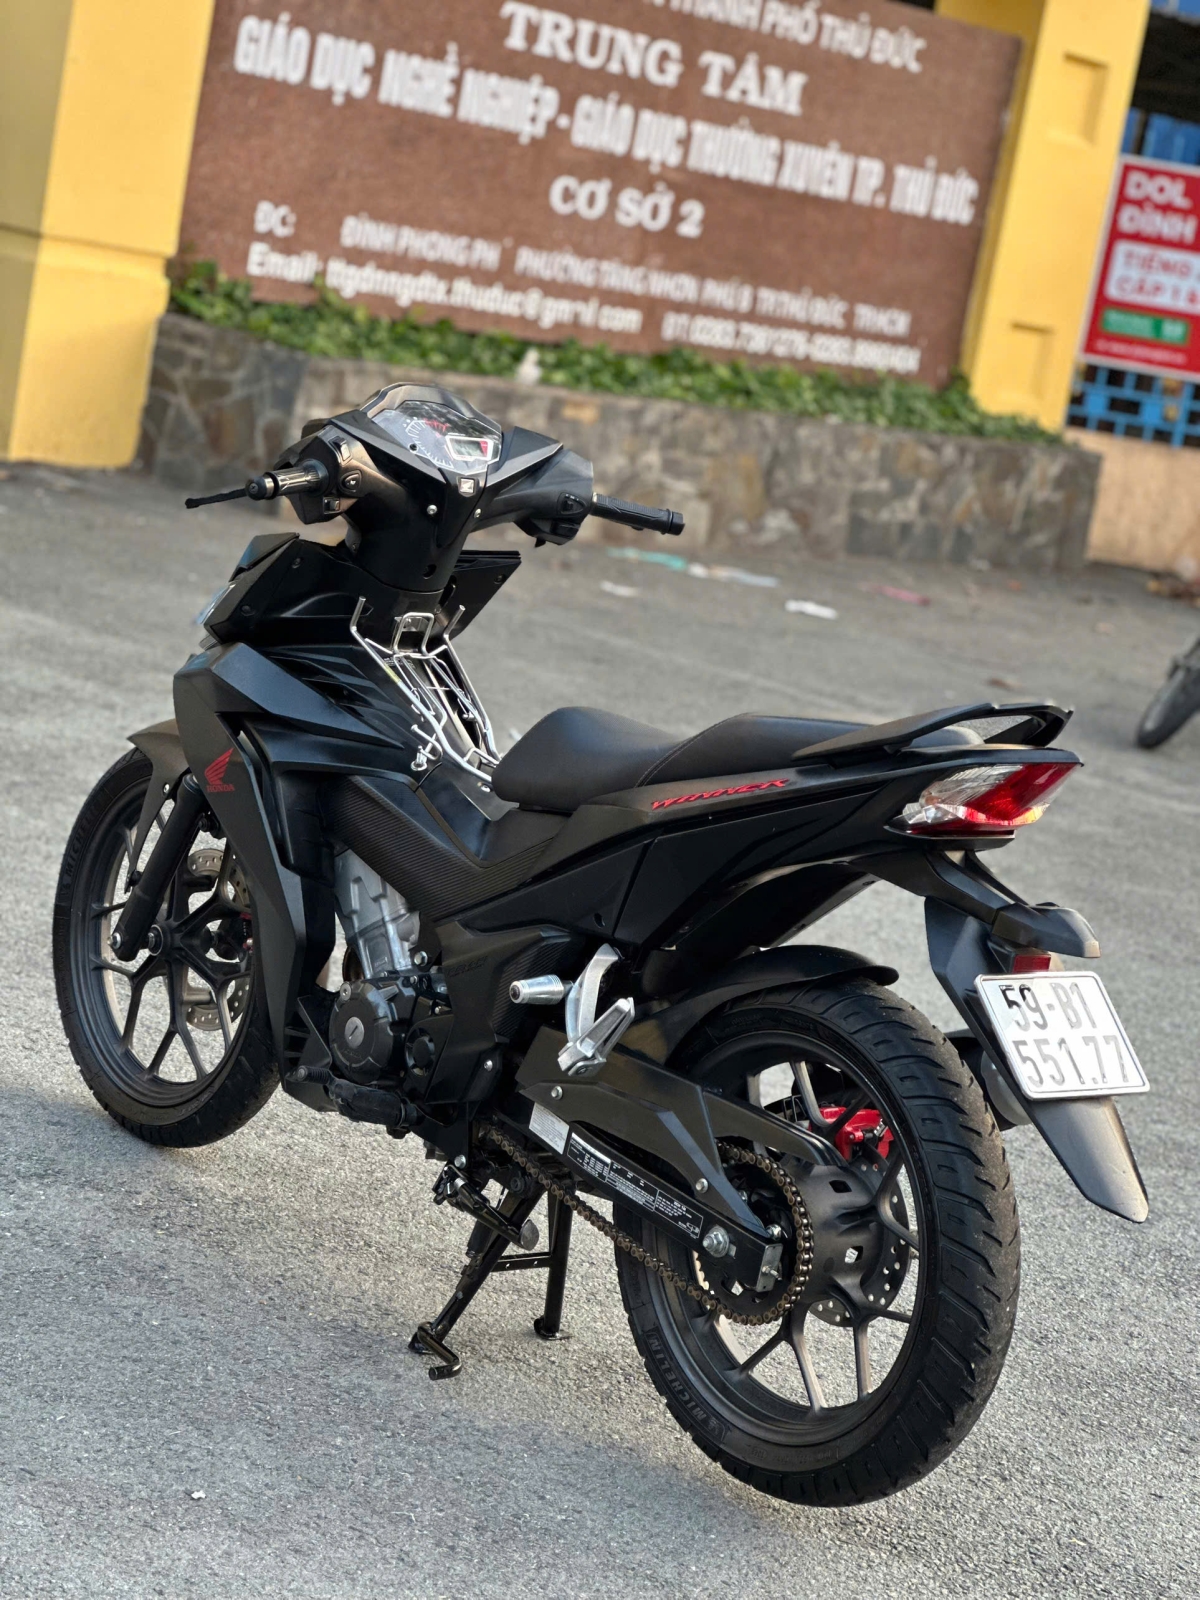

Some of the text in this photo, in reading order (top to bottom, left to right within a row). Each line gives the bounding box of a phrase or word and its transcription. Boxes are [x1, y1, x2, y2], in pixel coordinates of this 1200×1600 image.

[500, 0, 808, 116] TRUNG TÂM
[234, 12, 311, 85] GIÁO
[310, 32, 375, 106] DỤC
[377, 41, 459, 118] NGHỀ
[457, 67, 559, 145] NGHIỆP
[570, 91, 635, 157] GIÁO
[632, 108, 687, 174] DỤC
[549, 175, 705, 238] CƠ SỞ 2
[206, 784, 235, 792] HONDA
[998, 982, 1097, 1032] 59-B1
[1012, 1035, 1129, 1086] 551.77
[647, 1338, 708, 1420] MICHELIN
